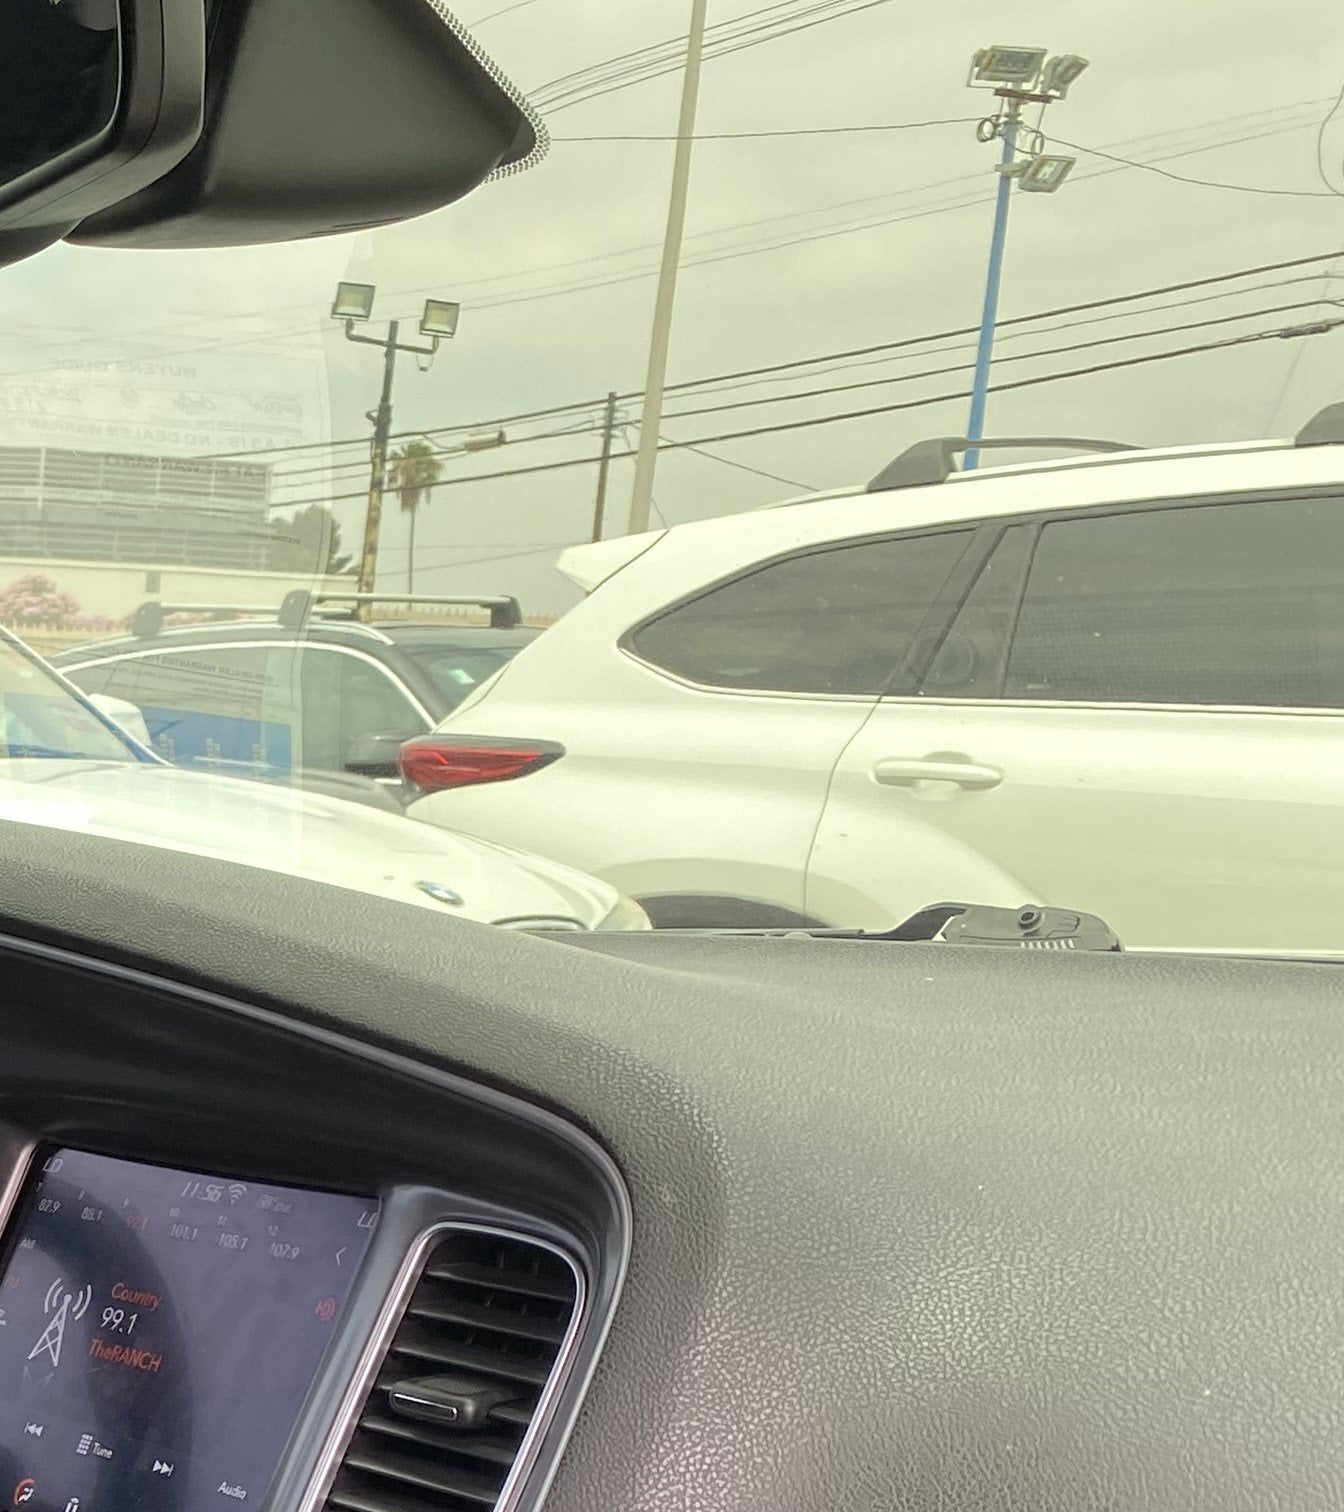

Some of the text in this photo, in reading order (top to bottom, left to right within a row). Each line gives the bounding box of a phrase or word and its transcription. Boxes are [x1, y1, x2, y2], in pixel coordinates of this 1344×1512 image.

[42, 1157, 64, 1173] LO
[37, 1198, 62, 1214] 87.9
[111, 1282, 162, 1312] Country
[99, 1306, 139, 1335] 99.1
[89, 1338, 163, 1372] TheRANCH
[91, 1441, 114, 1460] Tune
[217, 1481, 247, 1500] Audio
